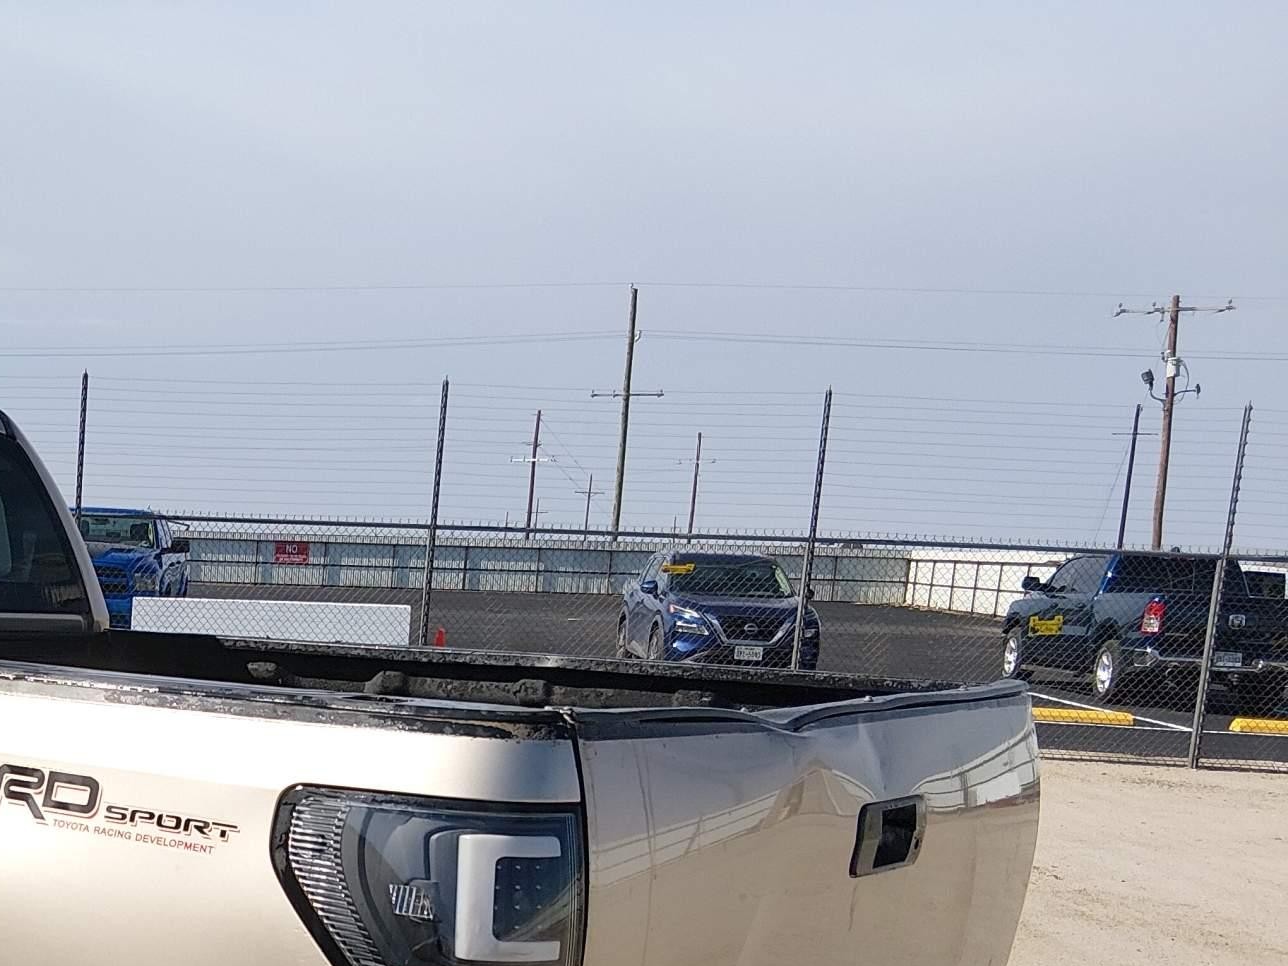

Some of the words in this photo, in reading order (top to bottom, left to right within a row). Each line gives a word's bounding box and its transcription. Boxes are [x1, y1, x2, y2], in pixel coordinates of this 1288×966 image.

[285, 544, 298, 554] NO
[52, 818, 90, 833] TOYOTA
[94, 825, 132, 841] RACING
[135, 833, 215, 855] DEVELOPMENT
[104, 804, 240, 842] SPORT
